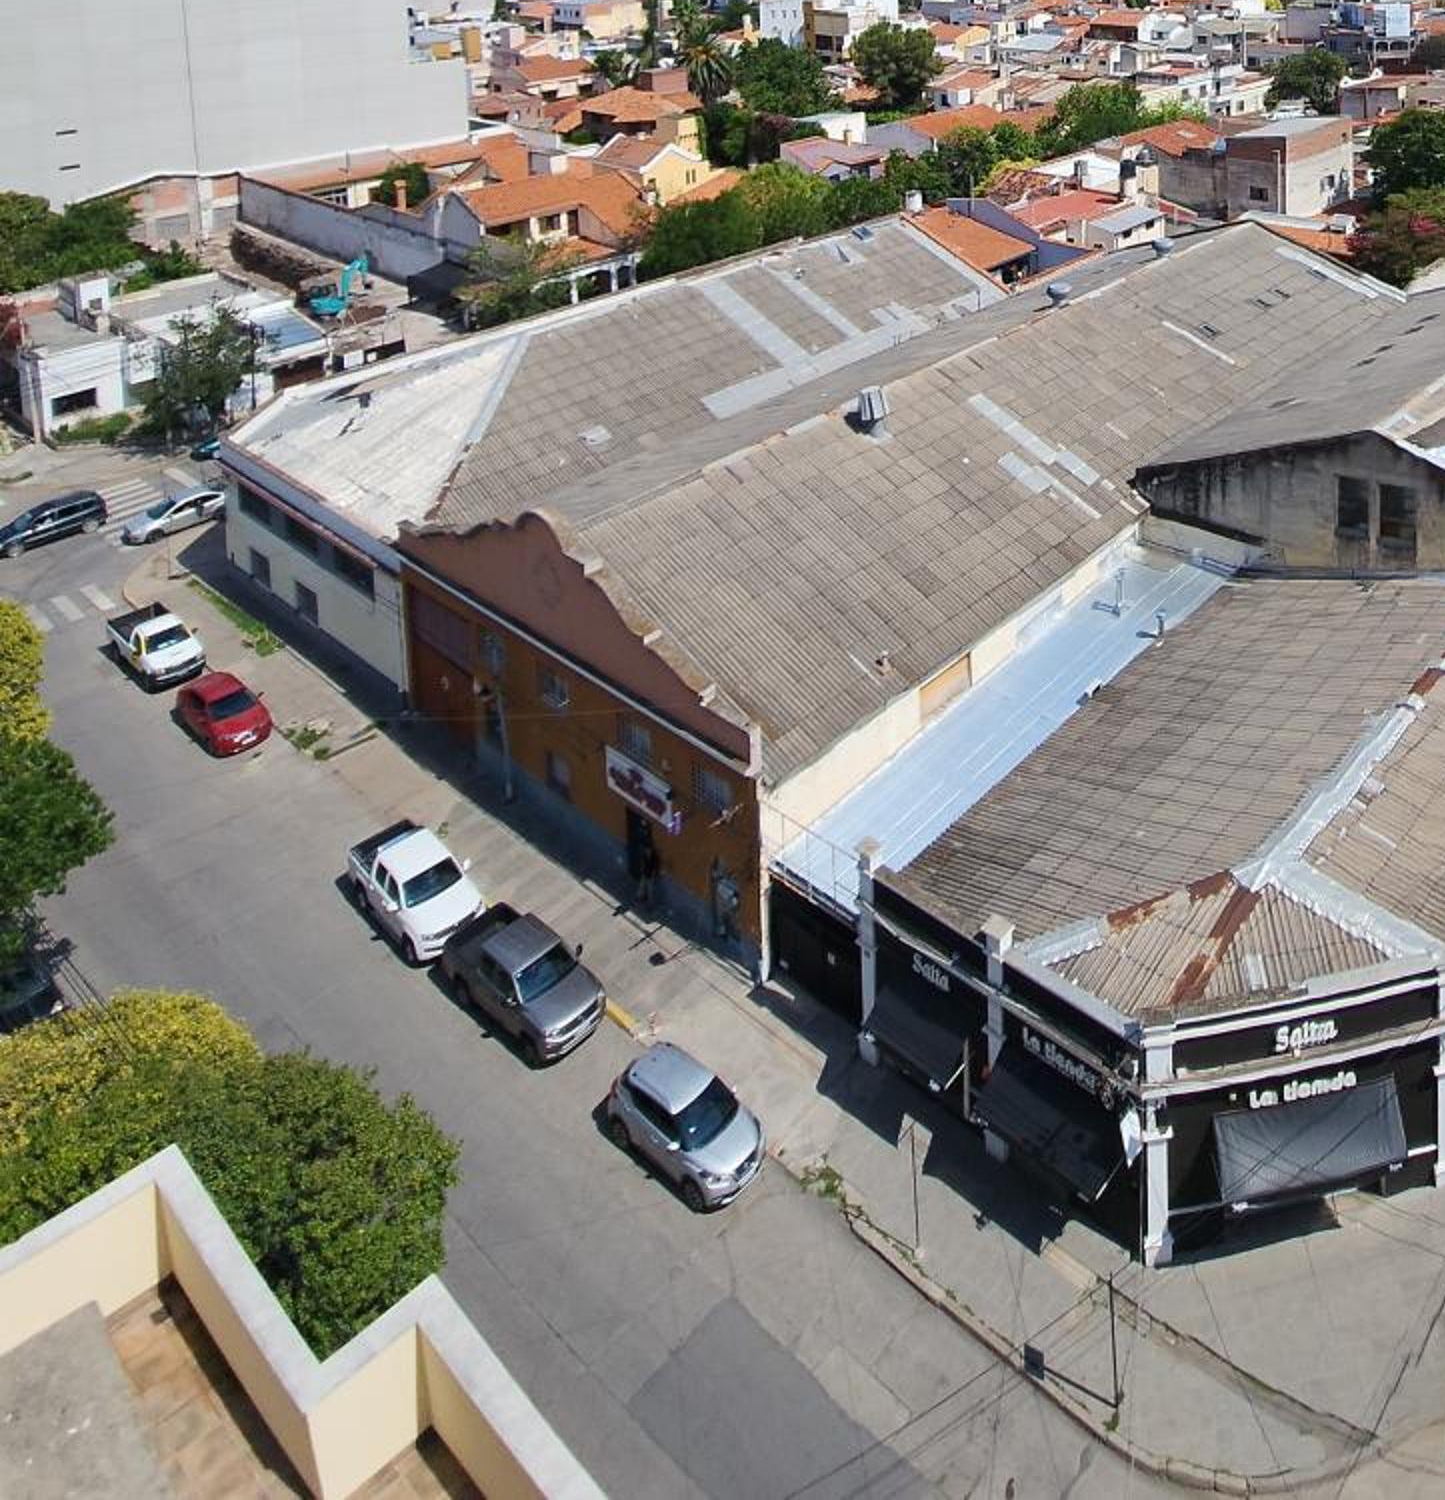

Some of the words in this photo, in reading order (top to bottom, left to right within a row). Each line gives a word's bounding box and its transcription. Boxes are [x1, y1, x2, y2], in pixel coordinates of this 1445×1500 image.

[1023, 1026, 1041, 1053] La
[1249, 1089, 1279, 1110] La
[1283, 1070, 1358, 1102] tienda
